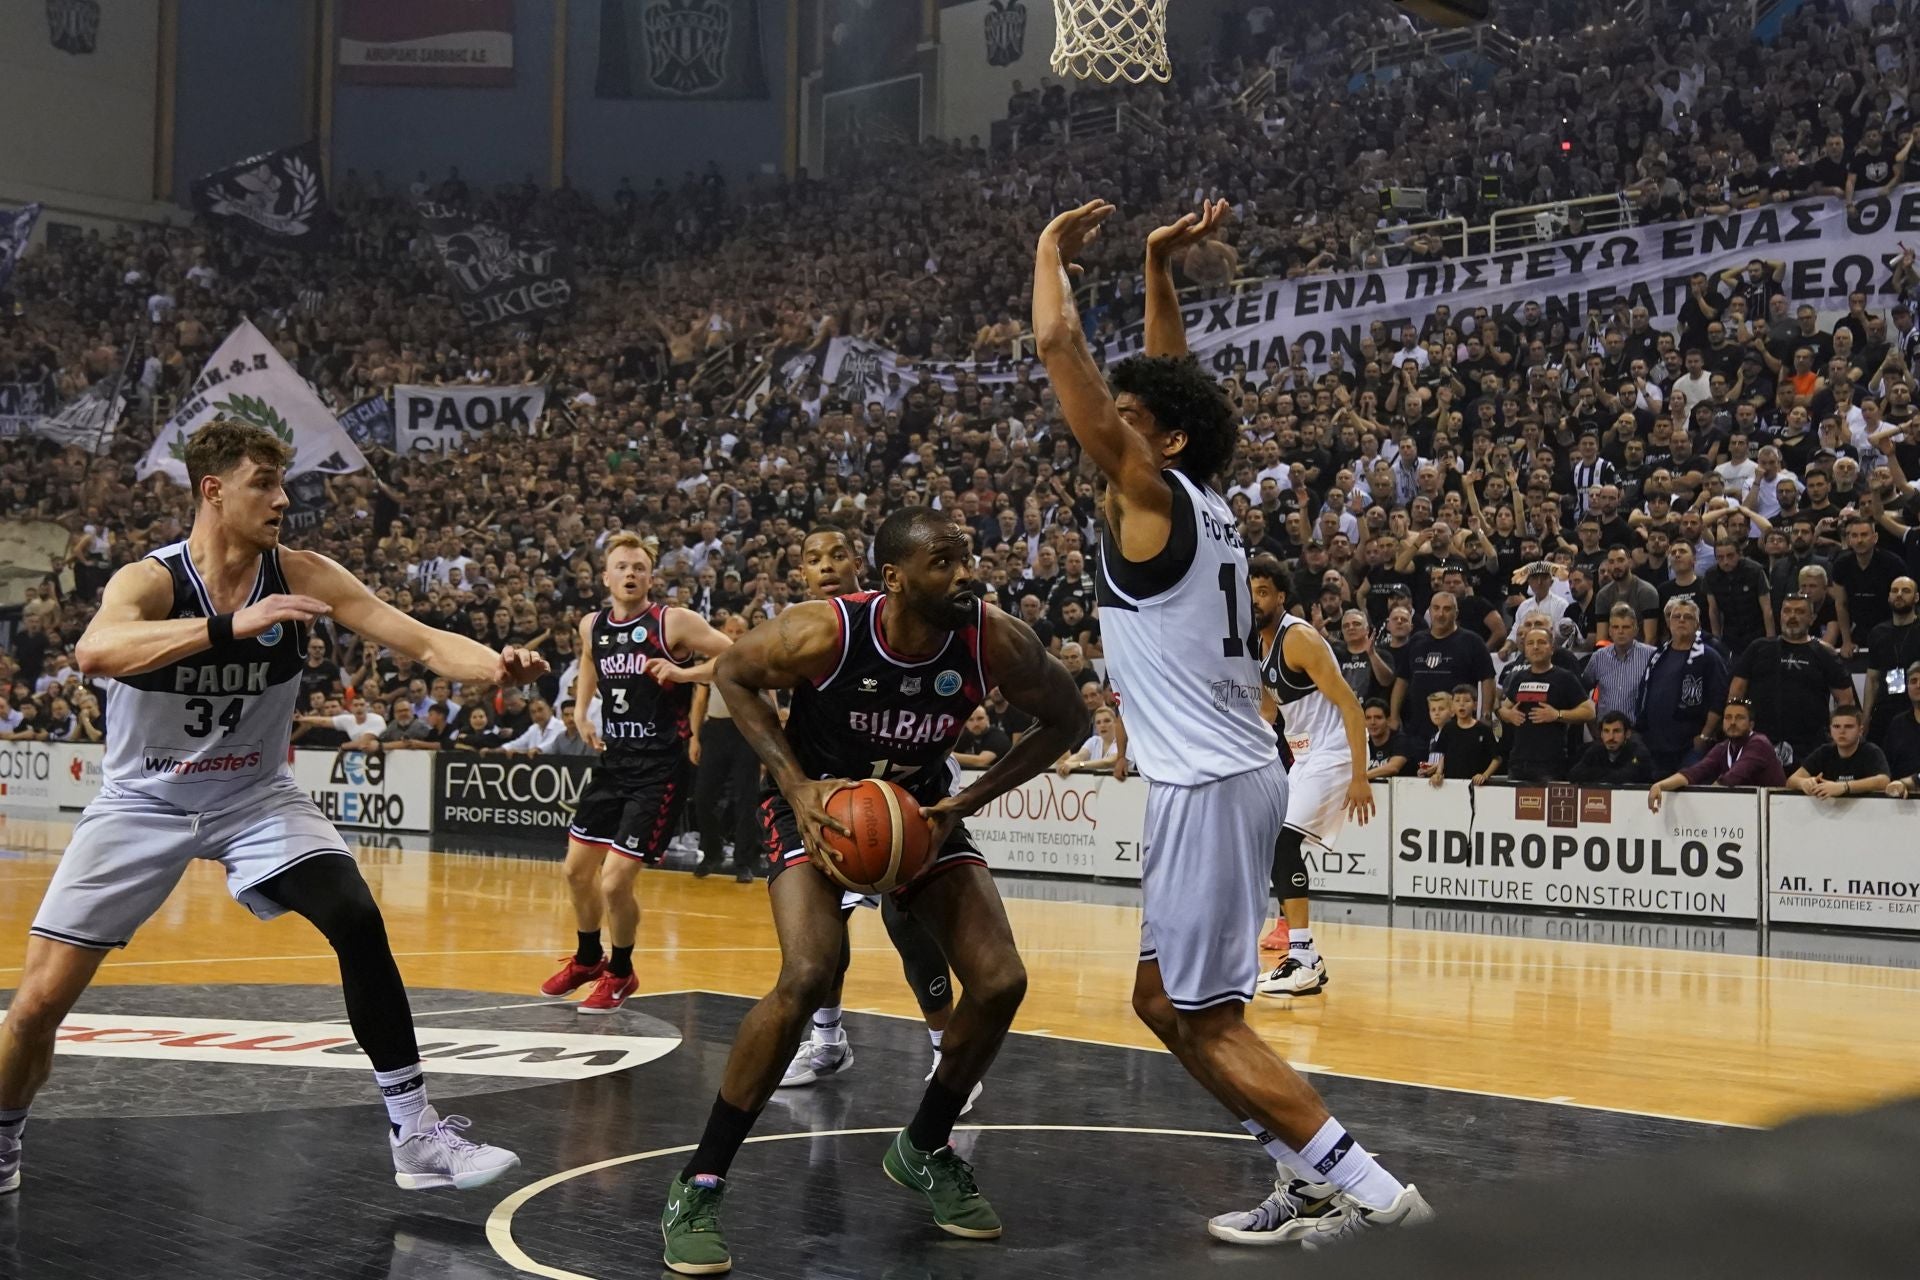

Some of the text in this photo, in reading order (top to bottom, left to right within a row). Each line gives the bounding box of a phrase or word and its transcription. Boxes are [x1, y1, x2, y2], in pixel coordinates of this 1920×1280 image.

[1294, 273, 1387, 317] ΕΝΑ
[1405, 236, 1640, 299] ΠΙΣΤΕΥΩ
[1662, 204, 1825, 260] ΕΝΑΣ
[1846, 192, 1920, 236] ΘΕ
[408, 396, 533, 431] PAOK
[174, 662, 271, 693] PAOK
[600, 653, 648, 675] BILBAO
[611, 688, 630, 714] 3
[184, 698, 244, 738] 34
[849, 709, 955, 744] BILBAO
[145, 752, 260, 775] winmasters
[445, 763, 592, 803] FARCOM
[312, 790, 404, 826] HELEXPO
[863, 796, 879, 848] molten
[1009, 831, 1035, 843] ΣΤΗΝ
[1037, 833, 1096, 847] ΤΕΛΕΙΟΤΗΤΑ
[1673, 827, 1744, 839] since 1960
[1007, 850, 1095, 866] ΑΠΟ ΤΟ 1931
[1398, 828, 1744, 880] SIDIROPOULOS
[1412, 875, 1726, 913] FURNITURE CONSTRUCTION
[1780, 876, 1920, 898] ΑΠ. Γ. ΠΑΠΟΥ
[1780, 896, 1873, 912] ΑΝΤΙΠΡΟΣΩΠΕΙΕΣ
[382, 1081, 417, 1096] GSA
